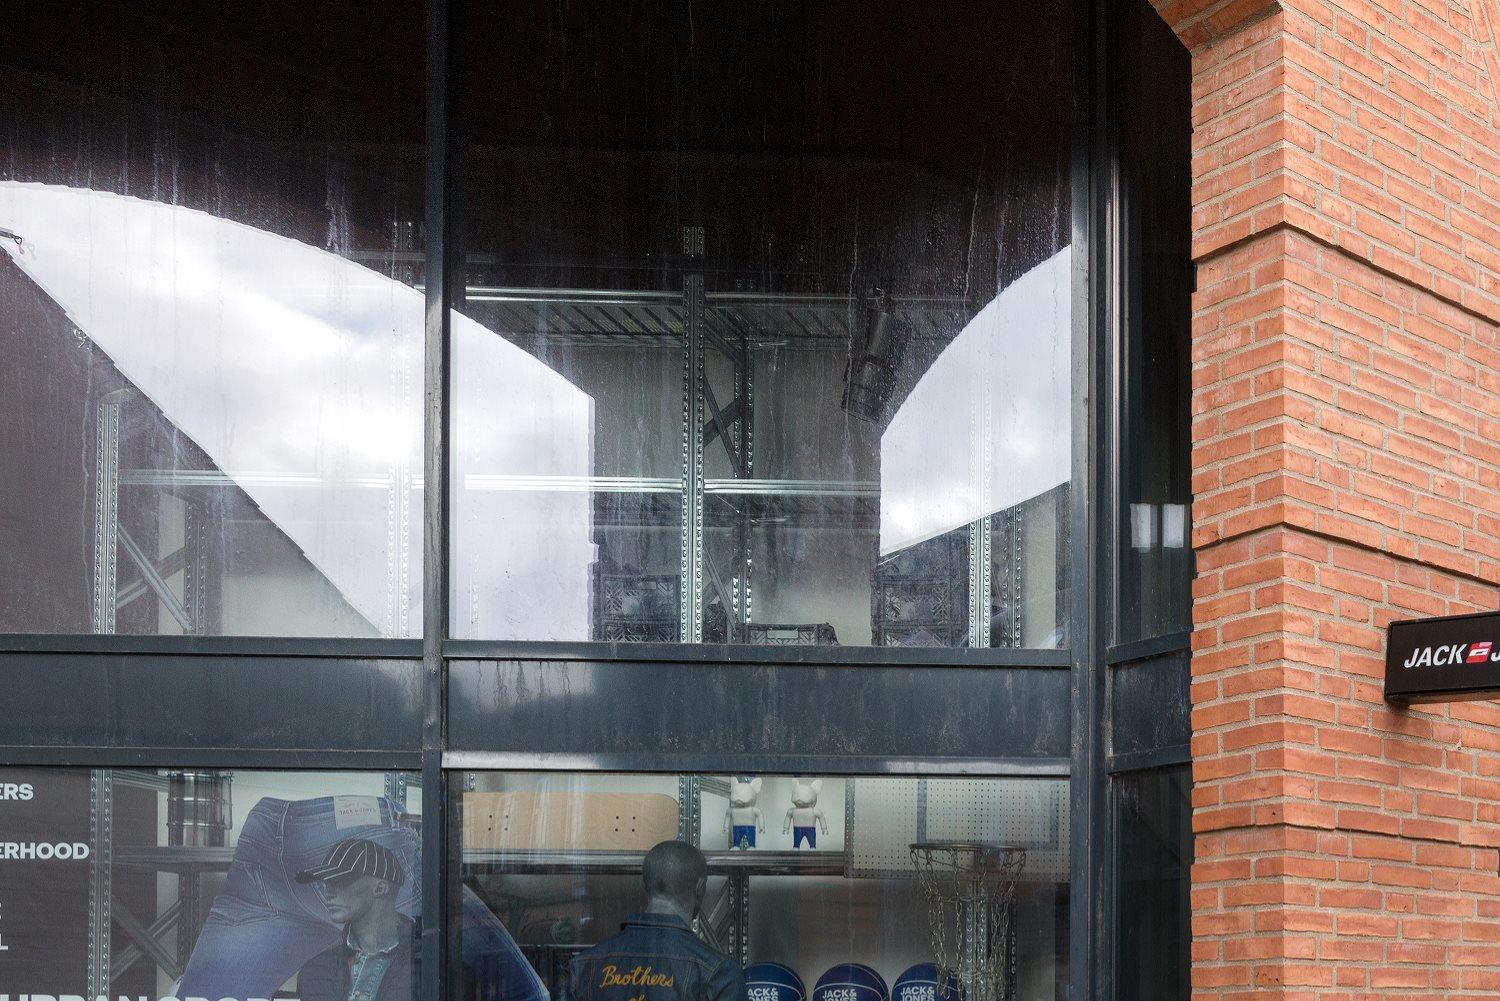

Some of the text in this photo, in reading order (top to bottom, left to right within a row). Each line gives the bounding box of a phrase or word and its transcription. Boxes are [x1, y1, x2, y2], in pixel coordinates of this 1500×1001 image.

[1404, 643, 1468, 668] JACK
[600, 965, 674, 988] Brothers
[748, 988, 779, 997] ACK&
